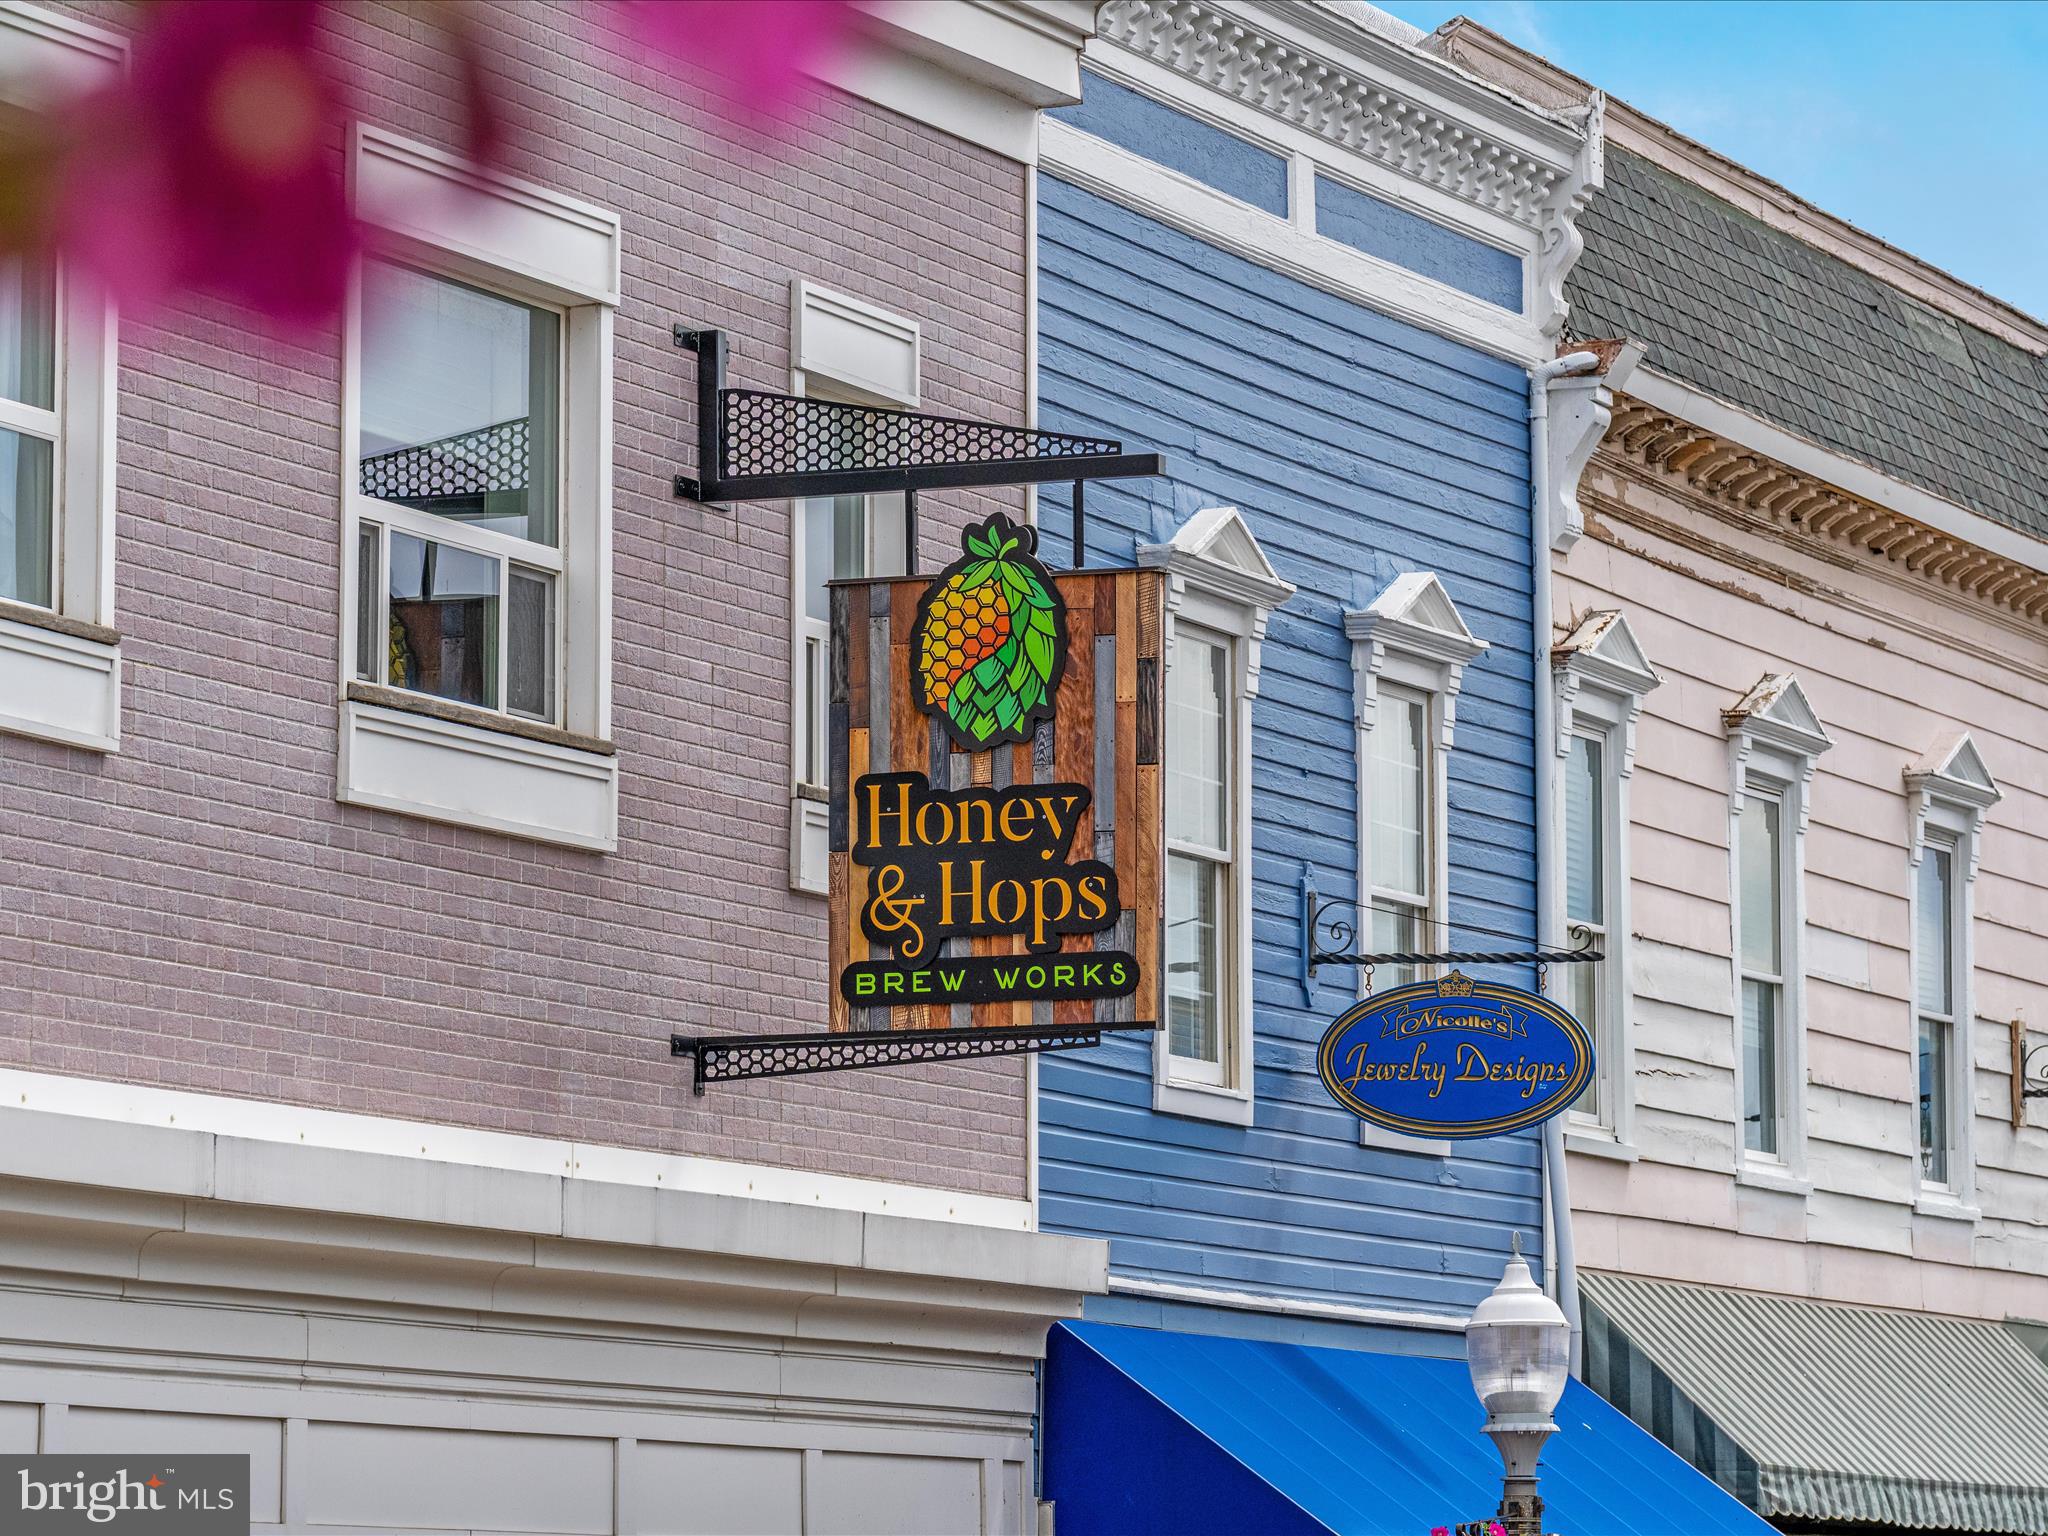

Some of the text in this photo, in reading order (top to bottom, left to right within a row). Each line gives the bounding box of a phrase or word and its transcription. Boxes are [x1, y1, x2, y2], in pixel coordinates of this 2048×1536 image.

[866, 782, 1079, 861] Honey
[870, 860, 1108, 958] & Hops
[855, 962, 1127, 995] BREW WORKS
[1400, 1007, 1509, 1035] Nicolle's
[1338, 1041, 1569, 1099] Jewelry Designs
